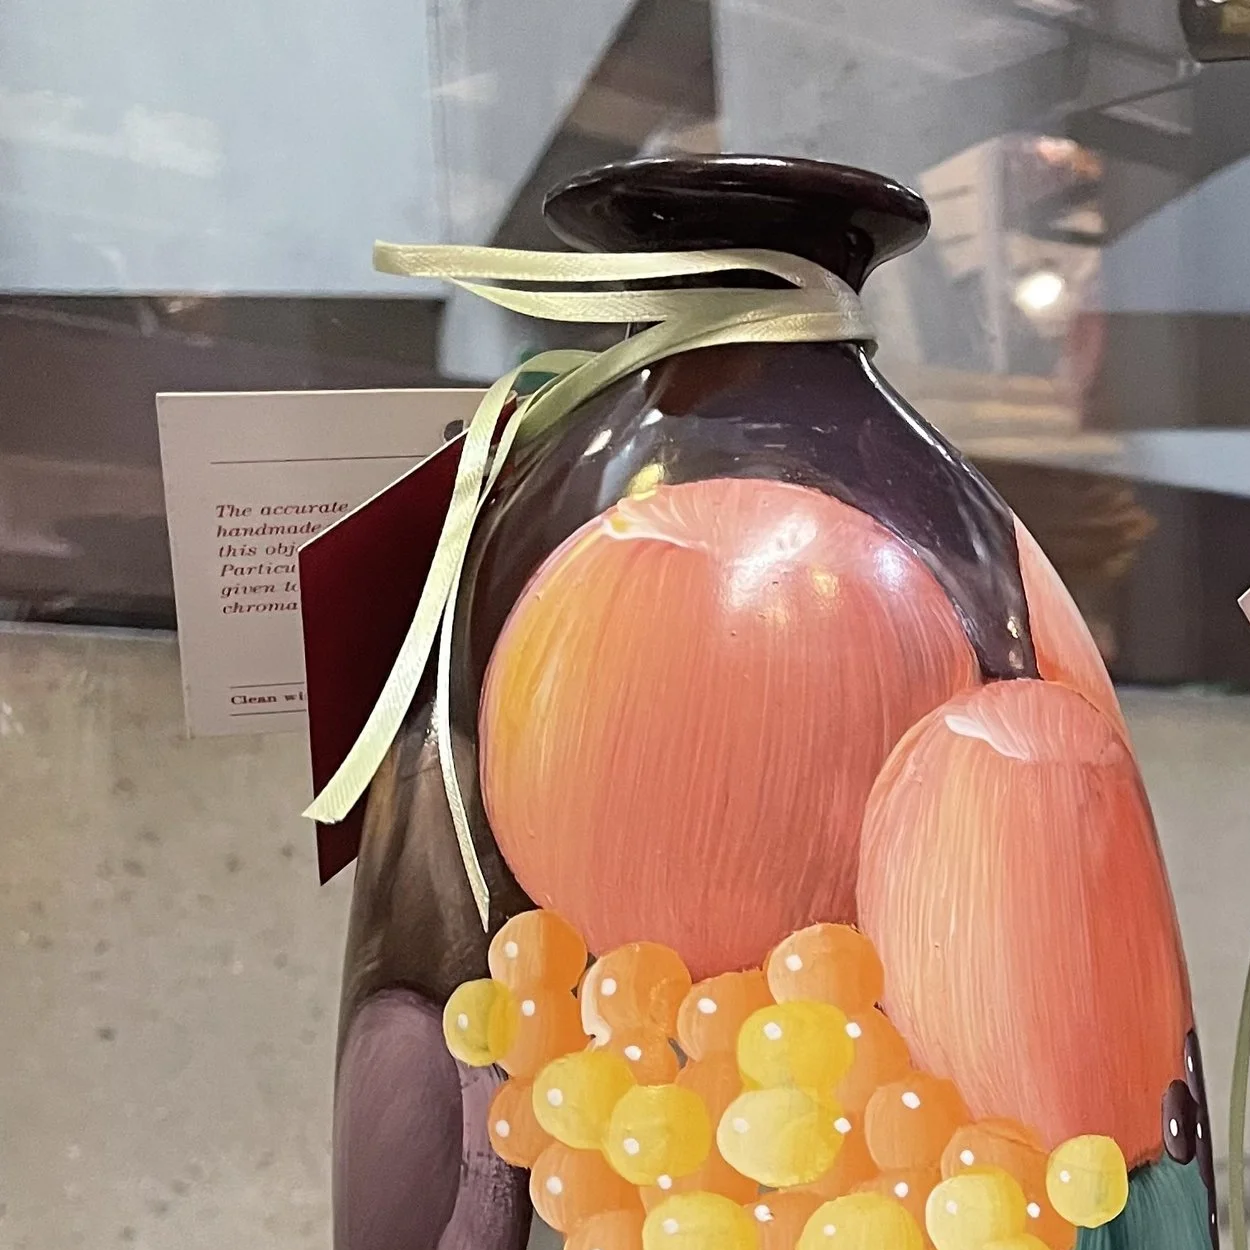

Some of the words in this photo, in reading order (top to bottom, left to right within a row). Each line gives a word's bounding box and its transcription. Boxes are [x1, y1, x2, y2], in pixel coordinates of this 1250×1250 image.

[216, 505, 252, 518] The
[260, 502, 349, 516] accurate
[217, 522, 322, 538] handmade
[219, 545, 257, 558] this
[220, 562, 296, 577] Particu
[221, 585, 276, 598] given
[223, 602, 298, 615] chroma
[231, 695, 277, 705] Clean
[284, 691, 304, 702] wi
